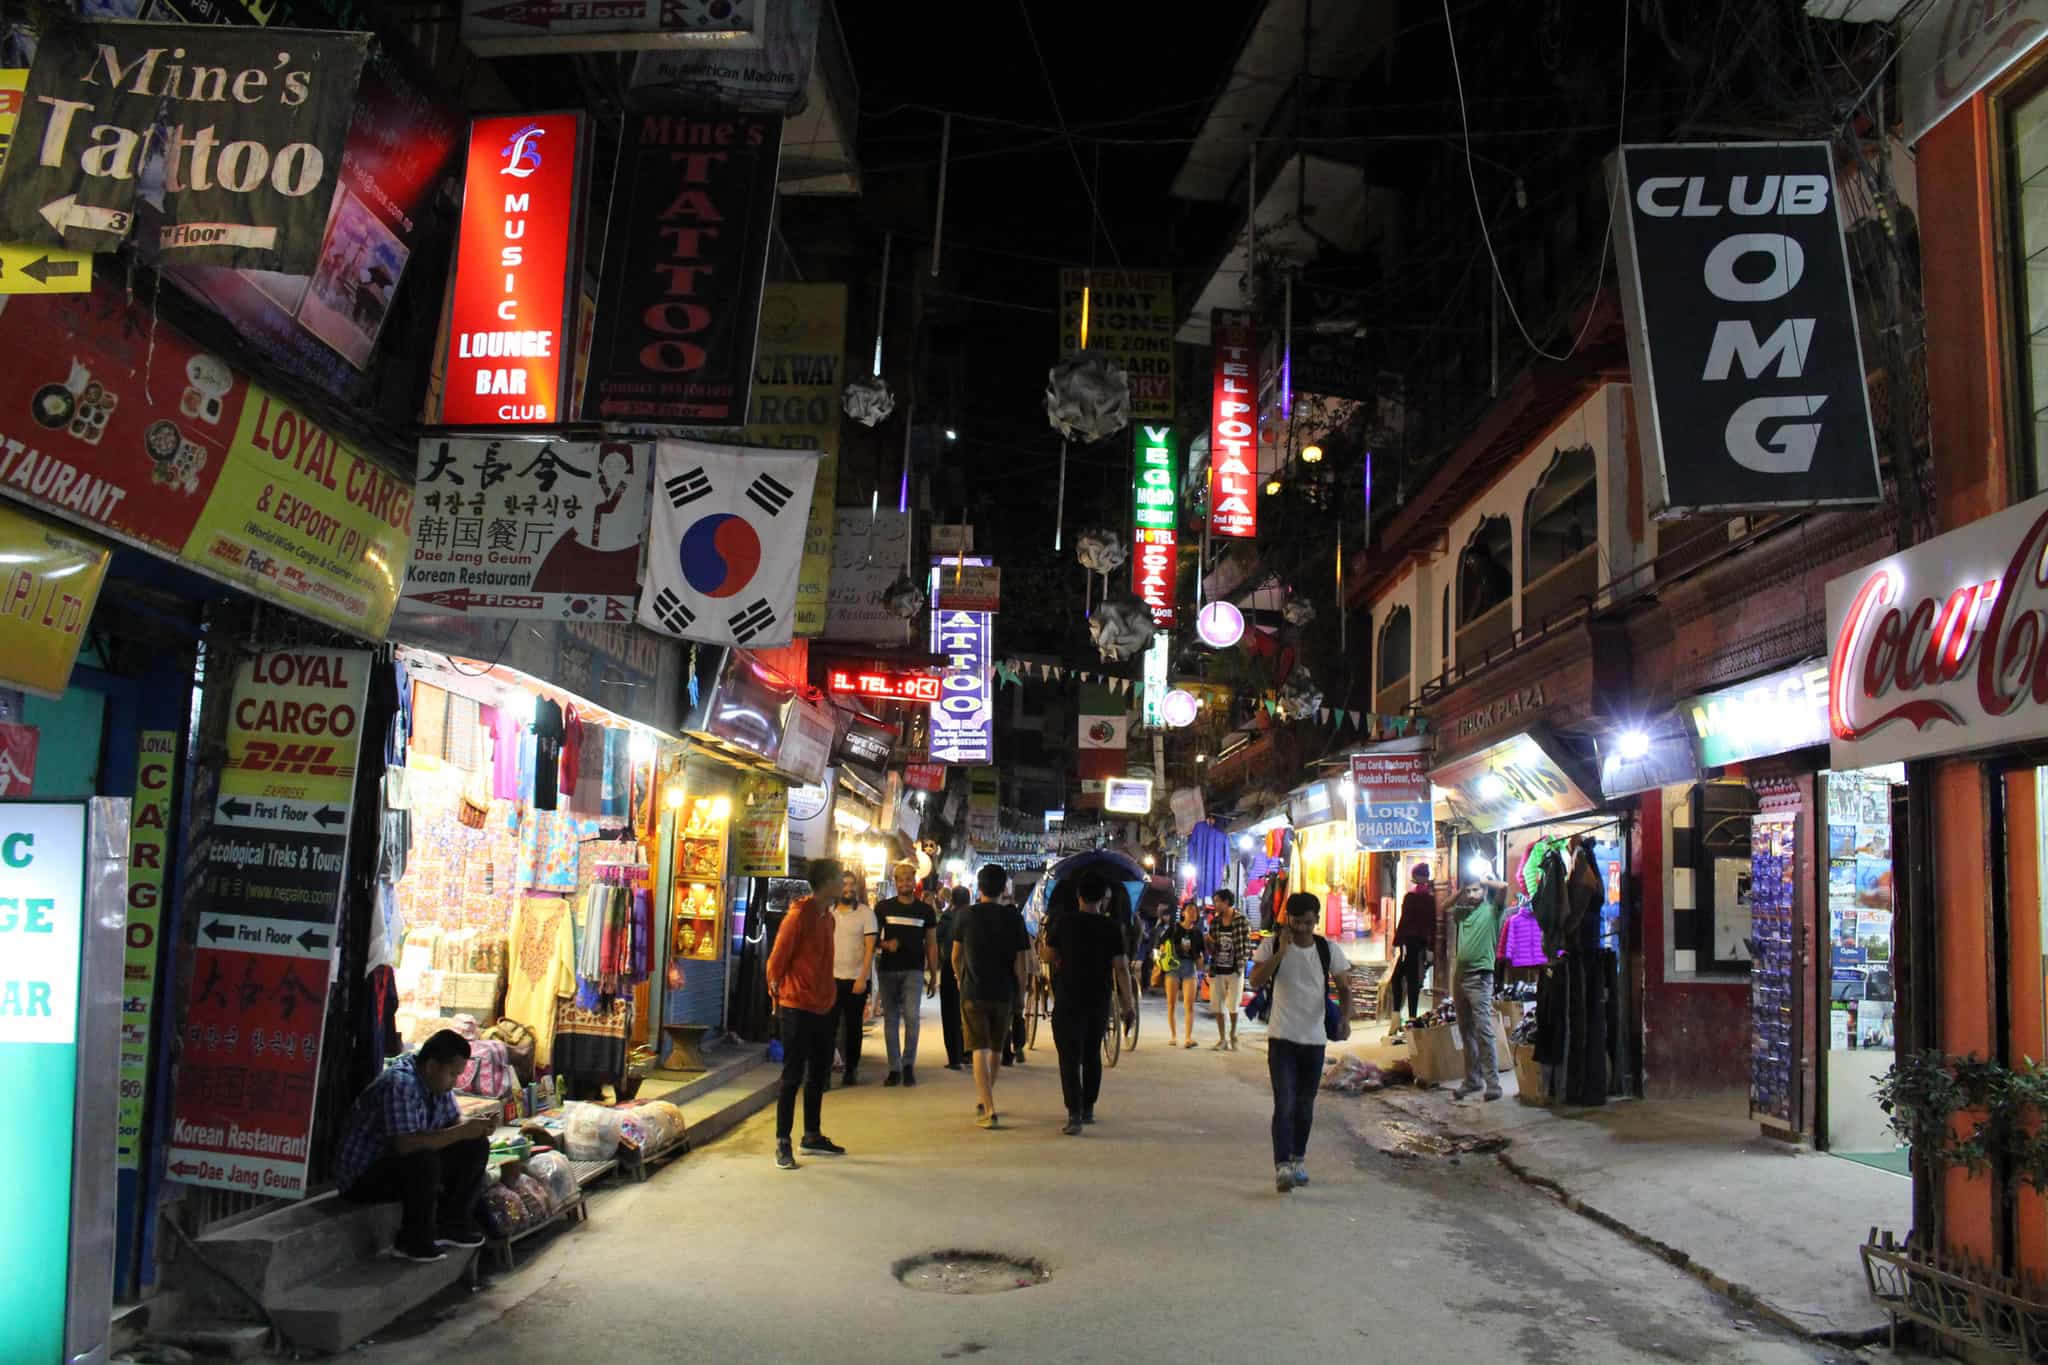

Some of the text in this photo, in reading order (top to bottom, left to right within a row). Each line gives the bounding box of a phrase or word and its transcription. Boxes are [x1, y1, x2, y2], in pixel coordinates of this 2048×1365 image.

[37, 94, 324, 198] Tattoo
[1636, 174, 1830, 218] CLUB
[175, 225, 227, 244] Floor
[497, 193, 530, 320] MUSIC
[459, 331, 552, 359] LOUNGE
[1701, 232, 1829, 474] OMG
[475, 368, 527, 395] BAR
[497, 404, 547, 421] CLUB
[251, 397, 338, 492] LOYAL
[1216, 400, 1253, 515] POTALA
[256, 484, 274, 513] &
[274, 492, 342, 547] EXPORT
[417, 514, 555, 554] 韩国餐厅
[1136, 529, 1175, 545] HOTEL
[246, 549, 280, 580] FedEx
[414, 548, 532, 566] Dae Jang Geum
[407, 565, 532, 588] Korean Restaurant
[1140, 545, 1169, 607] POTALA
[484, 595, 543, 609] Floor
[252, 653, 348, 689] LOYAL
[859, 675, 894, 694] TEL.
[235, 698, 356, 737] CARGO
[239, 741, 338, 776] DHL
[254, 803, 309, 822] First Floor
[1358, 821, 1431, 836] PHARMACY
[1368, 806, 1419, 819] LORD
[126, 764, 168, 949] CARGO
[208, 840, 343, 873] Ecological Treks & Tours
[238, 923, 293, 946] First Floor
[173, 1115, 307, 1158] Korean Restaurant
[199, 1161, 302, 1191] Dae Jang Geum
